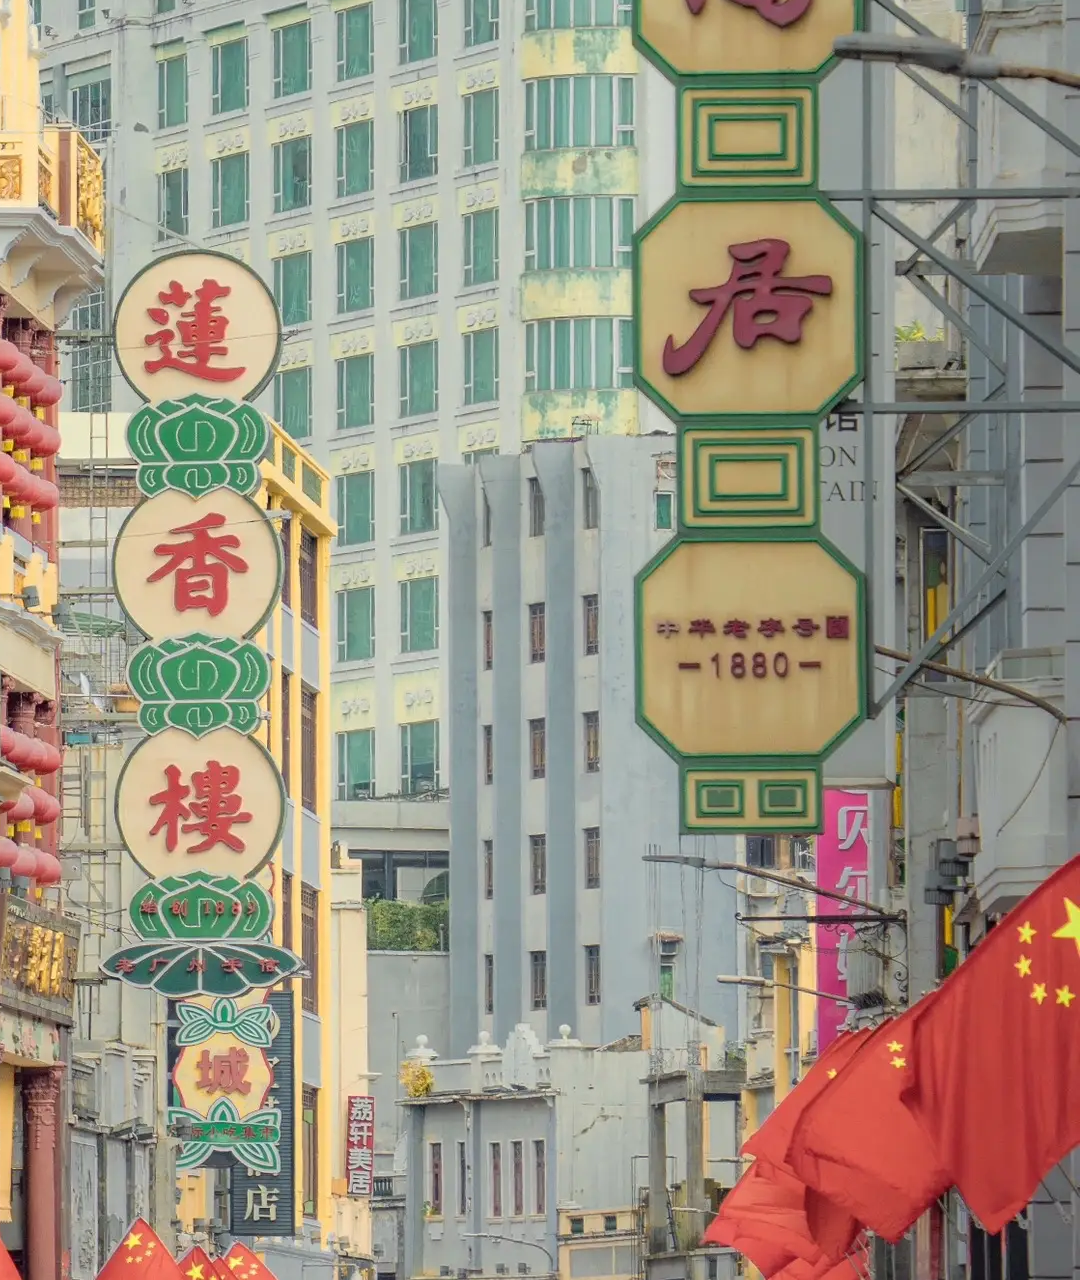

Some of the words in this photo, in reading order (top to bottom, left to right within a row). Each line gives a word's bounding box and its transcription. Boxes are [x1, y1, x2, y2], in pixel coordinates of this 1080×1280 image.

[143, 278, 254, 854] 蓮香樓
[656, 618, 820, 639] 中华老字号
[196, 1046, 252, 1096] 城
[348, 1097, 373, 1194] 荔轩美居
